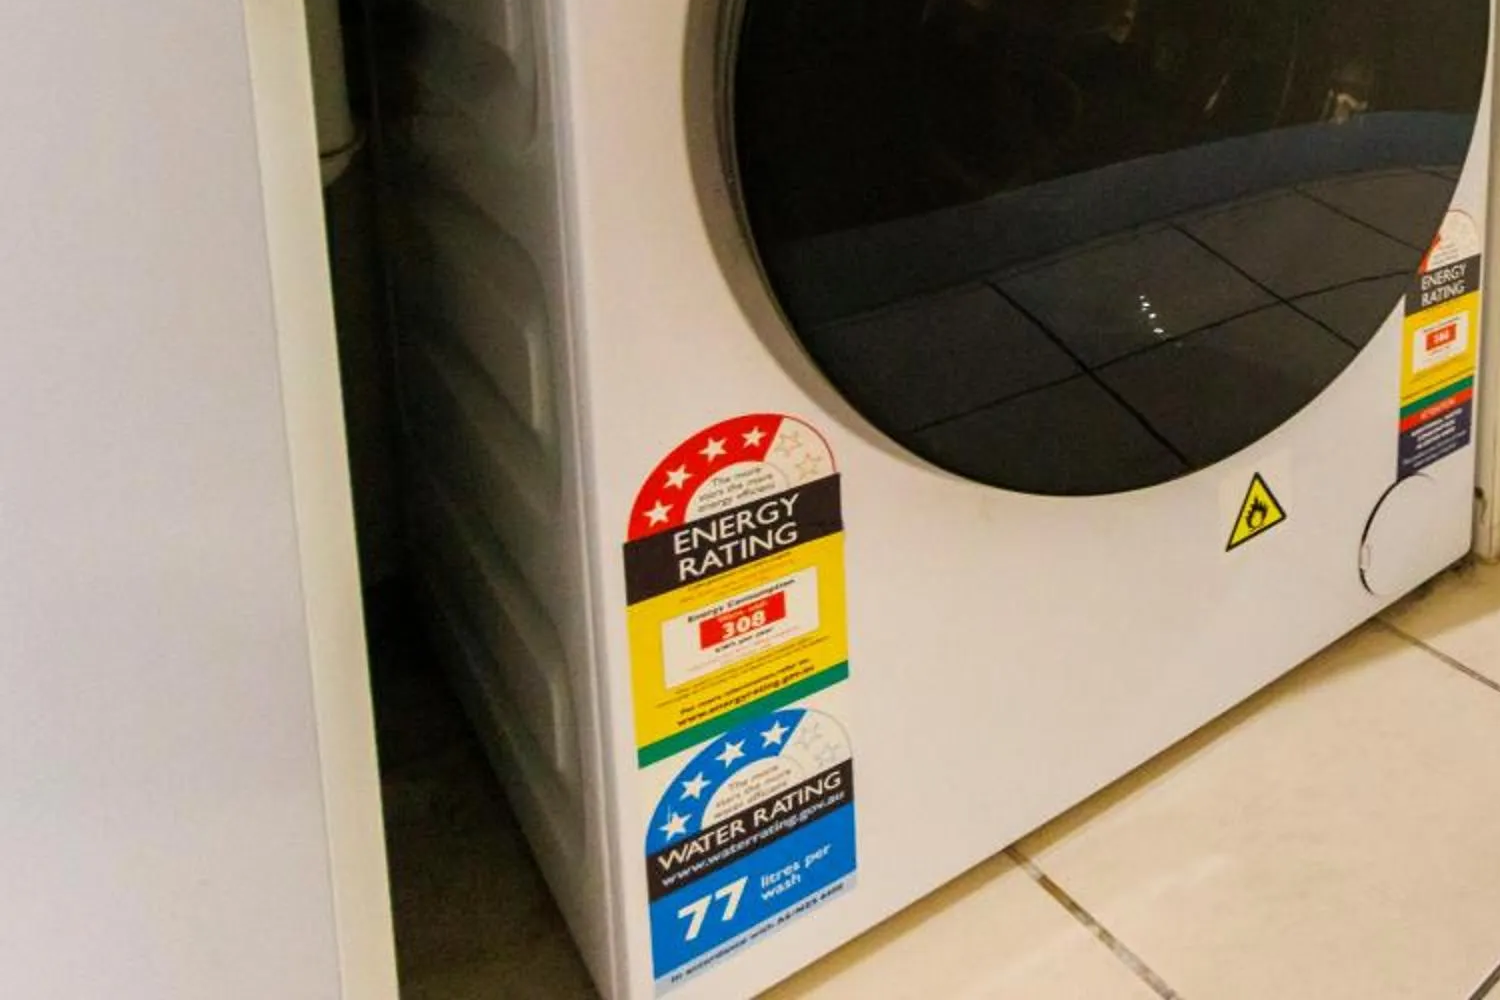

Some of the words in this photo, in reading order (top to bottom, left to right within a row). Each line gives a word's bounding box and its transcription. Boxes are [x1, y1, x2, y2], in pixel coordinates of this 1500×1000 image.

[1421, 263, 1467, 292] ENERGY
[1421, 279, 1465, 307] RATING
[673, 493, 800, 555] ENERGY
[679, 522, 798, 581] RATING
[687, 604, 724, 623] Energy
[721, 609, 767, 640] 308
[657, 819, 746, 871] WATER
[753, 770, 842, 828] RATING
[661, 790, 846, 887] www.waterrating.gov.au
[760, 860, 801, 889] litres
[804, 843, 832, 869] per
[761, 873, 801, 901] wash
[677, 875, 749, 941] 77
